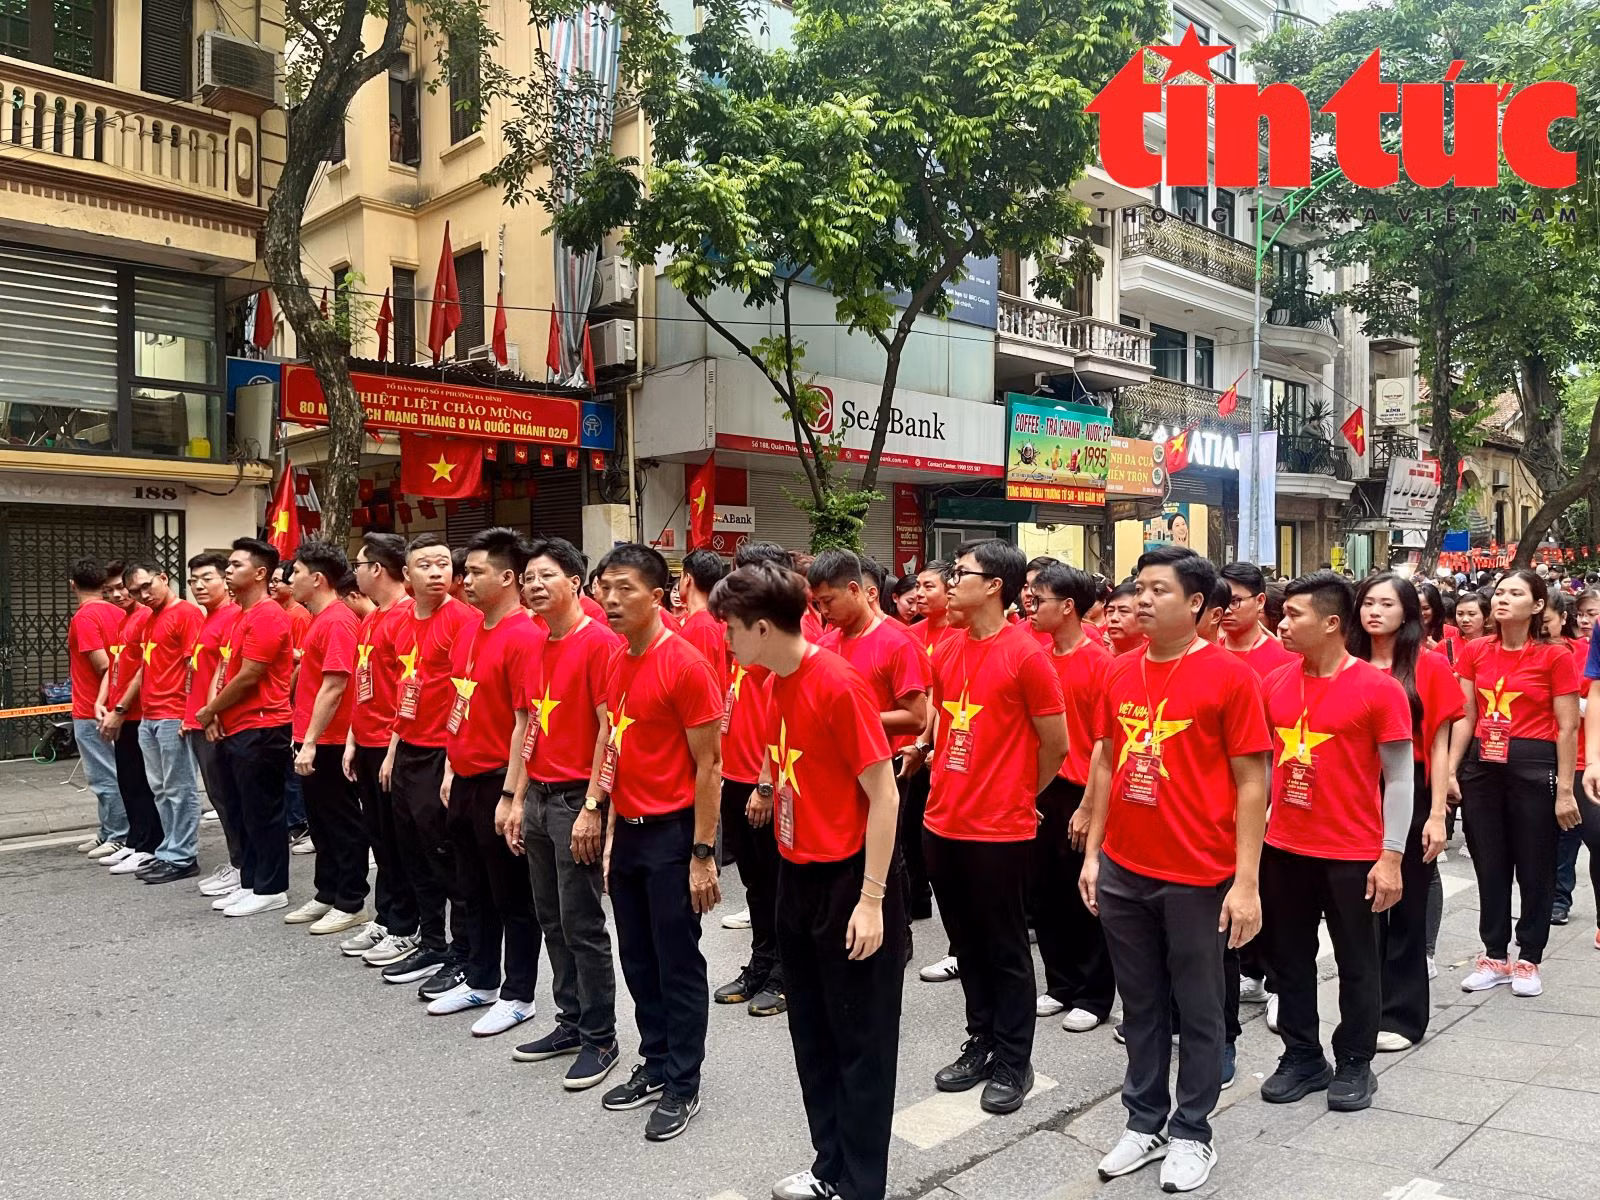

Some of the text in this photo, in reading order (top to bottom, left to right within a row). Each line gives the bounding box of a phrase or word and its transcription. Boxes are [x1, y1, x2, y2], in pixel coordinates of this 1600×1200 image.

[357, 391, 532, 421] HIỆT LIỆT CHÀO MỪNG
[300, 401, 315, 414] 80
[384, 409, 418, 425] MẠNG
[421, 412, 456, 429] THÁNG
[458, 417, 466, 430] 8
[468, 417, 481, 431] VÀ
[484, 418, 511, 433] QUỐC
[513, 423, 546, 437] KHÁNH
[548, 427, 569, 439] 02/9
[1014, 413, 1040, 434] COFFEE
[1059, 419, 1081, 439] CHANH
[1083, 445, 1107, 468] 1995
[132, 486, 177, 500] 188
